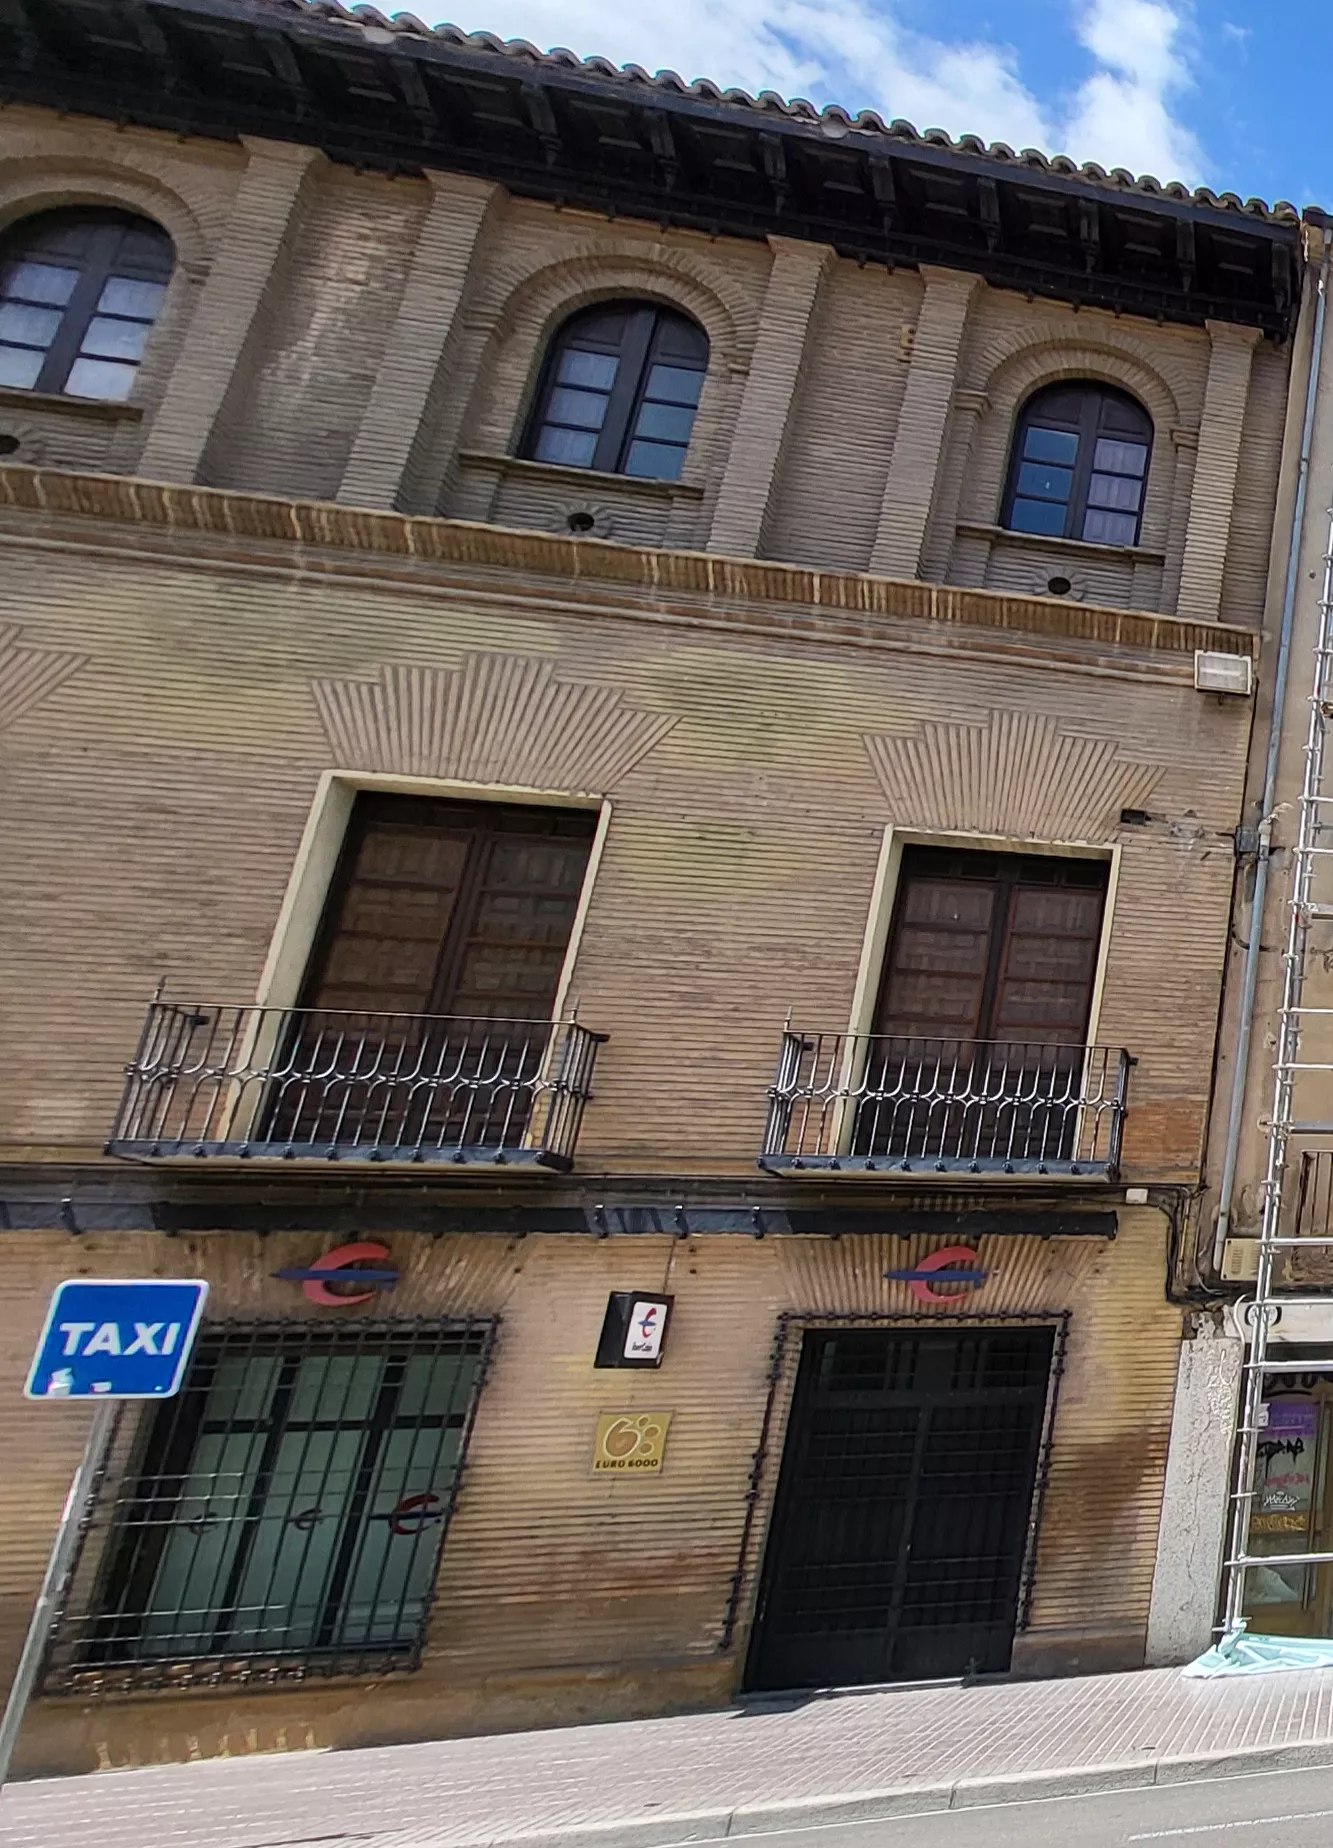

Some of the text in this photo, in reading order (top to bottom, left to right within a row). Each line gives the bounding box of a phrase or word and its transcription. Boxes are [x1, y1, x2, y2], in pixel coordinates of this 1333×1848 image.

[59, 1322, 182, 1356] TAXI
[595, 1458, 659, 1469] EURO 6000
